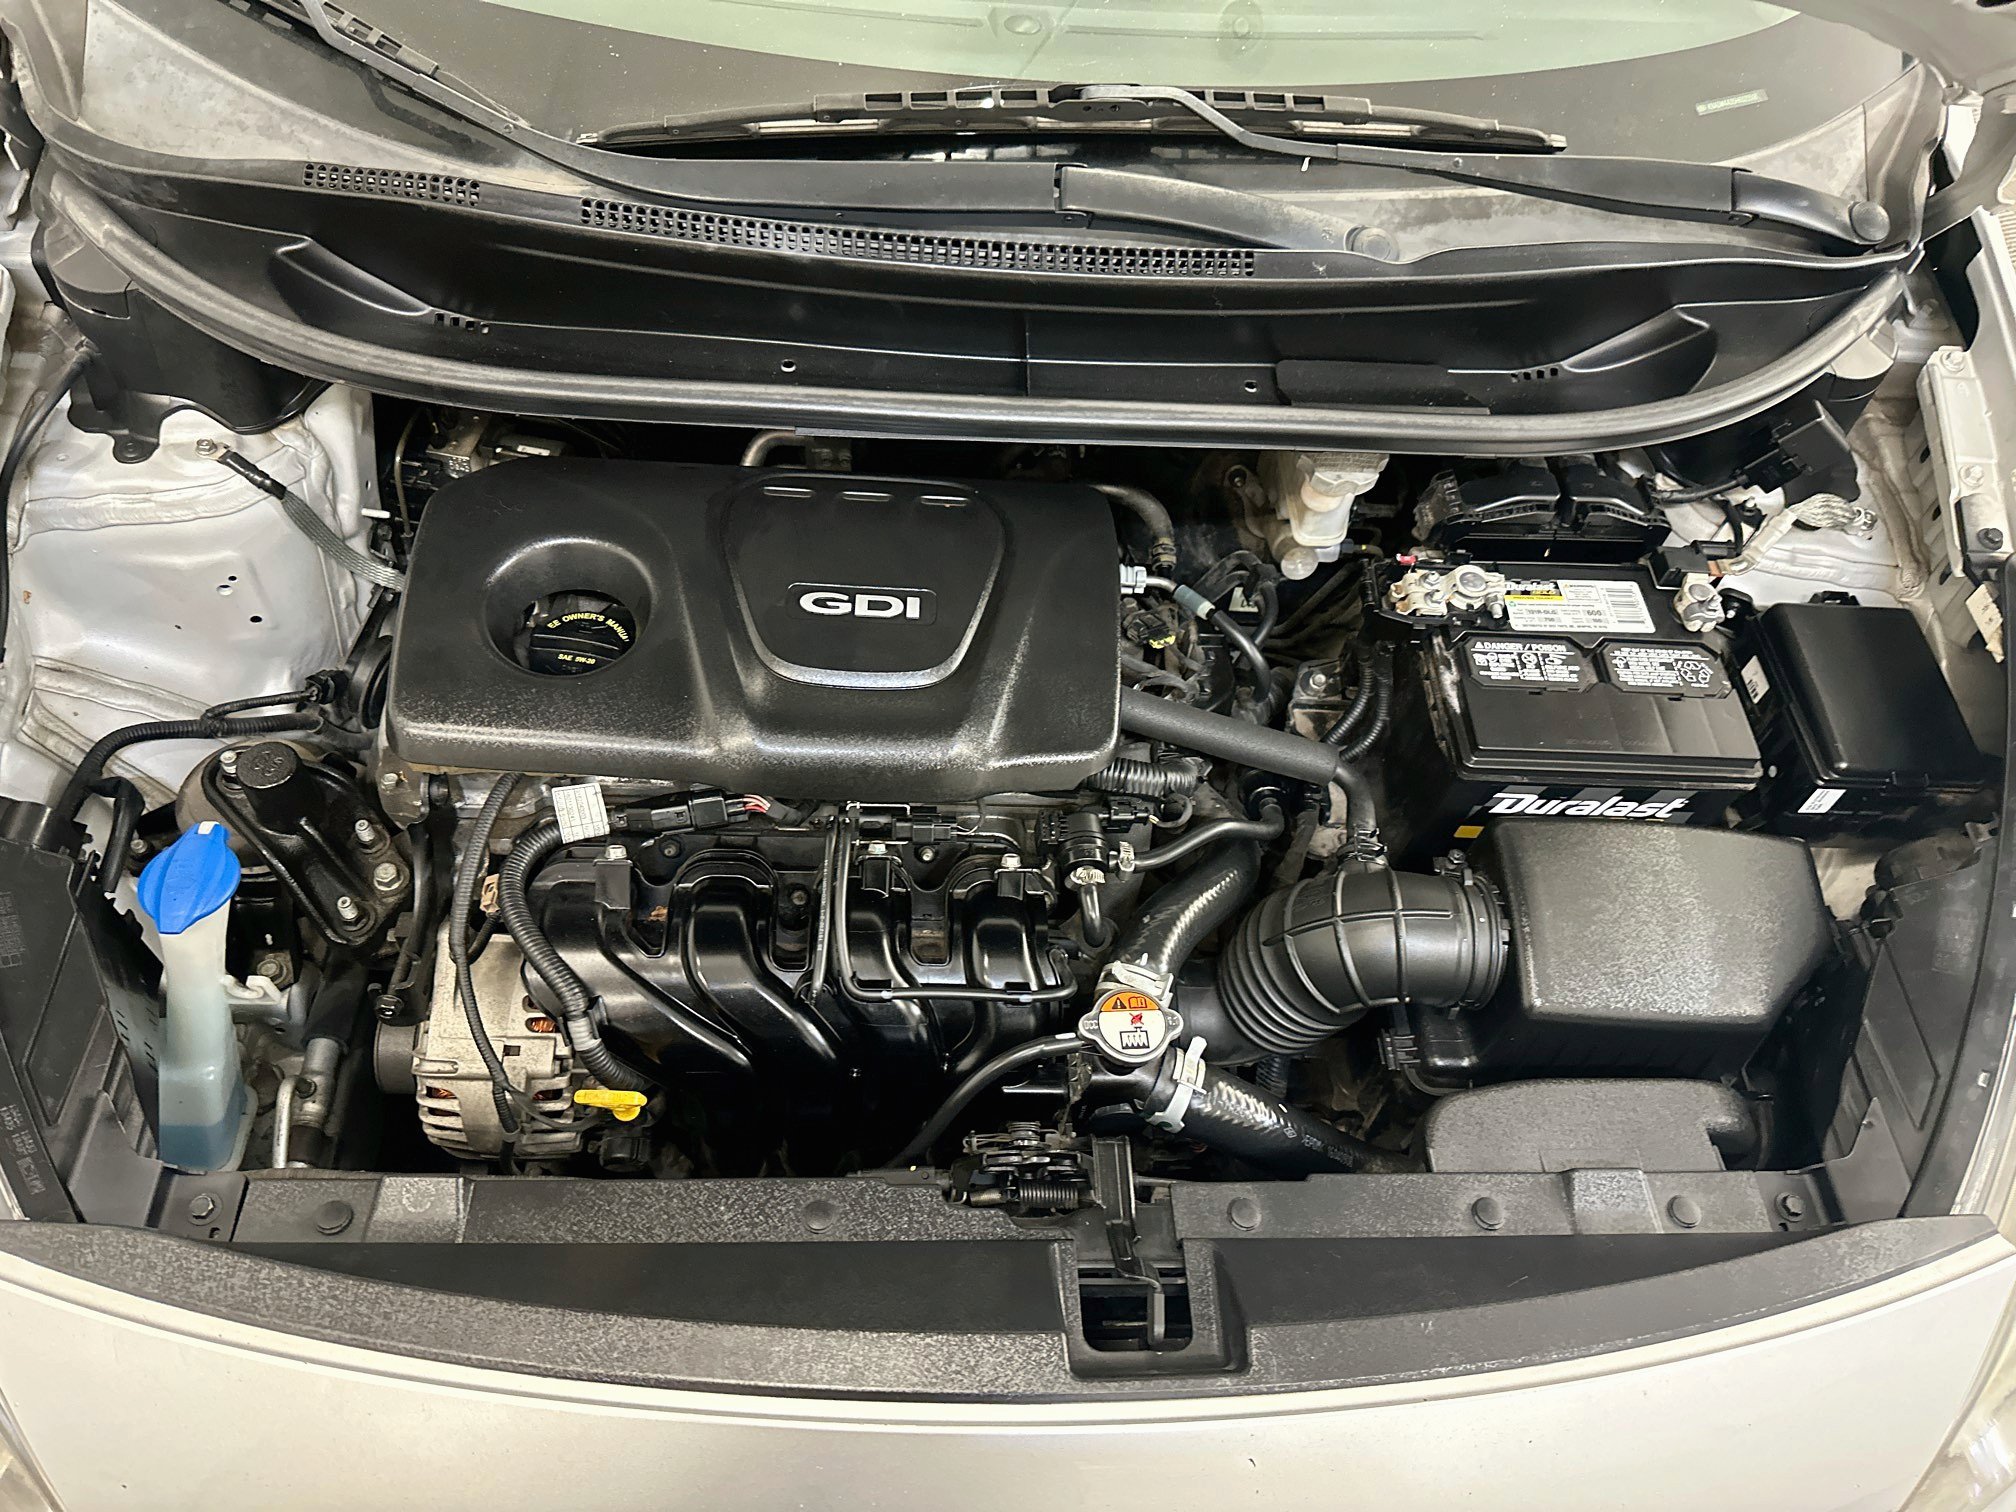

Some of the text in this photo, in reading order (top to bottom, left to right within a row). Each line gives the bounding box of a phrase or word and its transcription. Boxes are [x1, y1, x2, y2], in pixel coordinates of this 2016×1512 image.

[800, 592, 920, 619] GDI
[547, 619, 562, 629] EE
[562, 613, 605, 622] OWNER'S
[1483, 641, 1523, 650] DANGER
[1531, 643, 1567, 652] POISON
[558, 653, 596, 665] SAE 5W-20
[1488, 793, 1688, 818] Duralast
